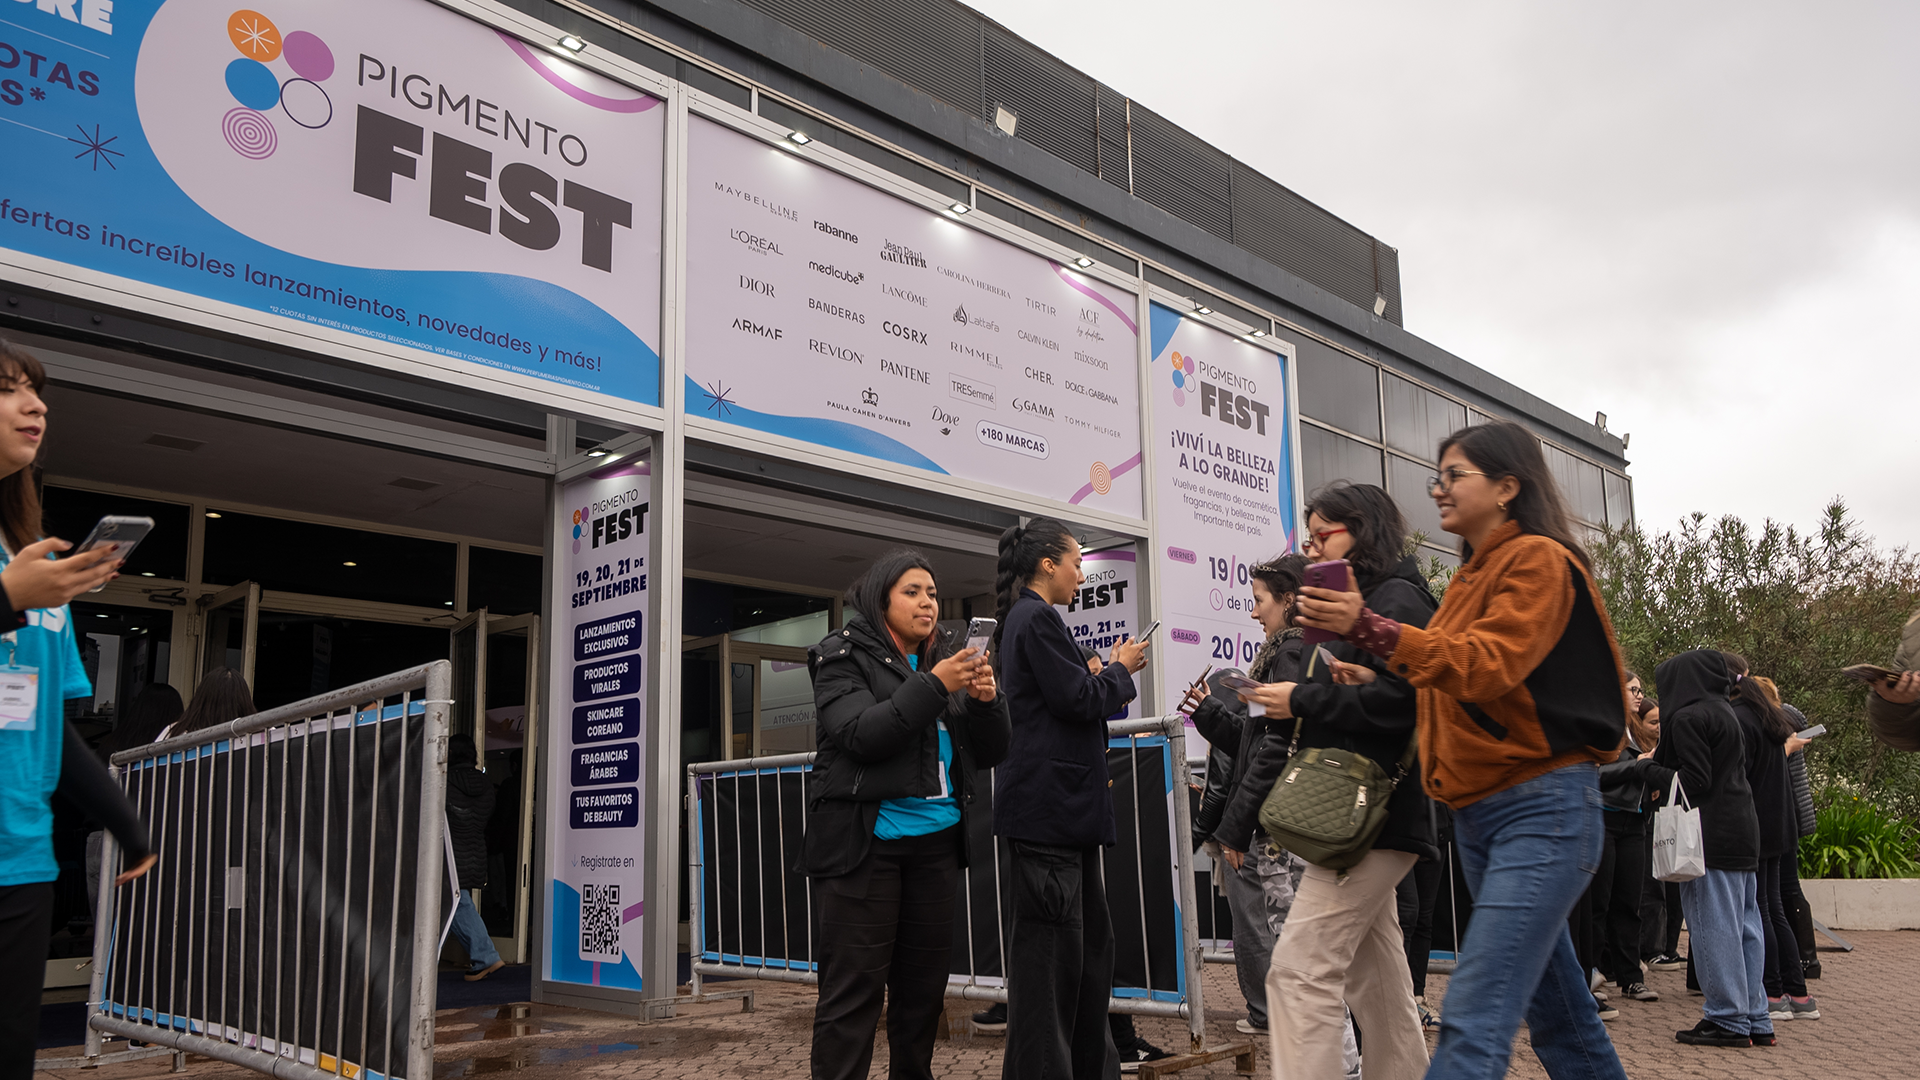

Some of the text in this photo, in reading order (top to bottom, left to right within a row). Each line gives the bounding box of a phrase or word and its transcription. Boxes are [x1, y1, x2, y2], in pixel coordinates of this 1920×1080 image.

[358, 53, 588, 167] PIGMENTO
[352, 103, 633, 272] FEST
[714, 181, 799, 219] MAYBELLINE
[812, 219, 859, 245] rabanne
[747, 246, 768, 257] PARIS
[879, 250, 928, 270] GAULTIER
[883, 238, 923, 262] Jean Paul
[808, 260, 861, 286] medicube
[936, 265, 1012, 300] CAROLINA HERRERA
[738, 273, 776, 299] DIOR
[881, 283, 929, 309] LANCÔME
[101, 225, 236, 279] increíbles
[244, 263, 411, 327] lanzamientos,
[418, 313, 532, 355] novedades
[538, 344, 549, 363] y
[554, 348, 602, 373] más!
[807, 297, 866, 326] BANDERAS
[1024, 296, 1057, 318] TIRTIR
[967, 312, 1001, 334] Lattafa
[1079, 307, 1100, 325] ACF
[279, 308, 306, 320] CUOTAS
[306, 315, 318, 323] SIN
[341, 323, 351, 331] EN
[350, 325, 387, 340] PRODUCTOS
[435, 346, 446, 354] VER
[445, 349, 463, 359] BASES
[503, 362, 512, 371] EN
[731, 317, 784, 341] ARMAF
[881, 319, 929, 347] COSRX
[1017, 329, 1061, 352] CALVIN KLEIN
[808, 338, 864, 366] REVLON
[949, 340, 1003, 367] RIMMEL
[1073, 349, 1109, 372] mixsoon
[879, 358, 932, 386] PANTENE
[1023, 365, 1056, 386] CHER.
[1199, 360, 1257, 395] PIGMENTO
[951, 379, 996, 404] TRESemmé
[826, 400, 912, 428] PAULA CAHEN D'ANVERS
[931, 404, 961, 427] Dove
[1200, 380, 1271, 437] FEST
[1063, 415, 1091, 430] TOMMY
[1093, 424, 1122, 439] HILFIGER
[980, 427, 1046, 454] +180 MARCAS
[1170, 429, 1276, 476] ¡VIVÍ LA BELLEZA
[1178, 452, 1270, 494] A LO GRANDE!
[591, 488, 639, 516] PIGMENTO
[1171, 476, 1198, 493] Vuelve
[1198, 485, 1206, 496] el
[1206, 489, 1232, 503] evento
[1232, 494, 1242, 506] de
[1182, 493, 1271, 527] fragancias, y belleza más
[1193, 510, 1234, 530] Importante
[1234, 521, 1246, 533] del
[591, 501, 649, 550] FEST
[1168, 549, 1195, 563] VIERNES
[576, 556, 644, 588] 19, 20, 21 DE
[1208, 554, 1254, 589] 19/0
[571, 573, 647, 609] SEPTIEMBRE
[1067, 580, 1129, 613] FEST
[1226, 595, 1254, 613] de 10
[579, 617, 636, 641] LANZAMIENTOS
[1073, 619, 1126, 638] 20, 21 DE
[1171, 629, 1199, 643] SÁBADO
[583, 634, 630, 655] EXCLUSIVOS
[583, 661, 630, 681] PRODUCTOS
[590, 679, 621, 695] VIRALES
[586, 705, 625, 722] SKINCARE
[773, 709, 810, 726] ATENCIÓN
[586, 721, 624, 738] COREANO
[580, 749, 629, 766] FRAGANCIAS
[589, 764, 619, 780] ÁRABES
[575, 793, 633, 809] TUS FAVORITOS
[583, 810, 624, 824] DE BEAUTY
[580, 855, 636, 872] Registrate en
